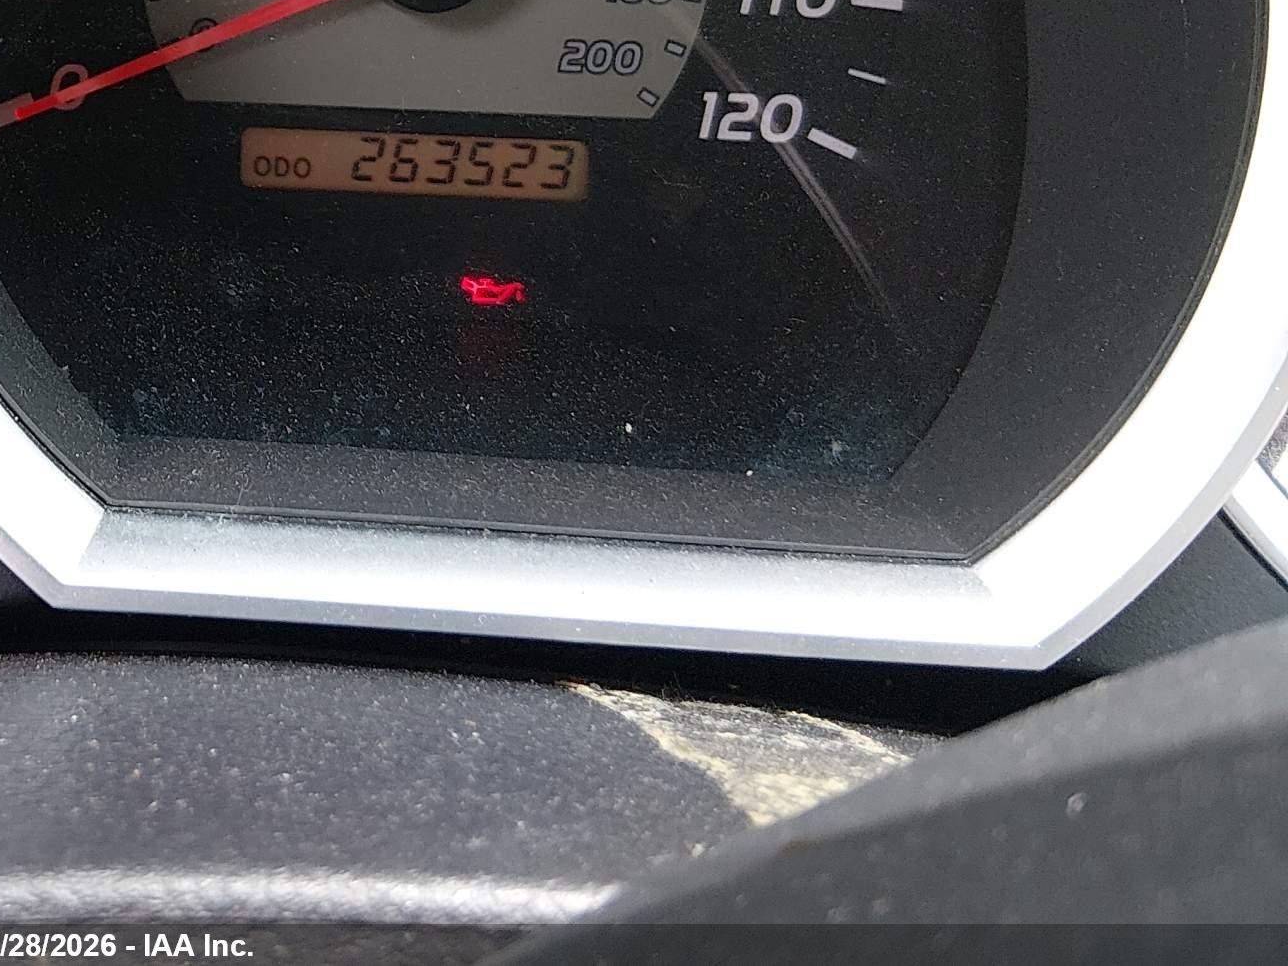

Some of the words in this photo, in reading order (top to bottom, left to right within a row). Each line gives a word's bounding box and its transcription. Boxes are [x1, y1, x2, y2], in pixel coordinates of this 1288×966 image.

[557, 39, 644, 76] 200
[697, 91, 803, 144] 120
[253, 155, 312, 178] ODO
[351, 136, 575, 190] 263523
